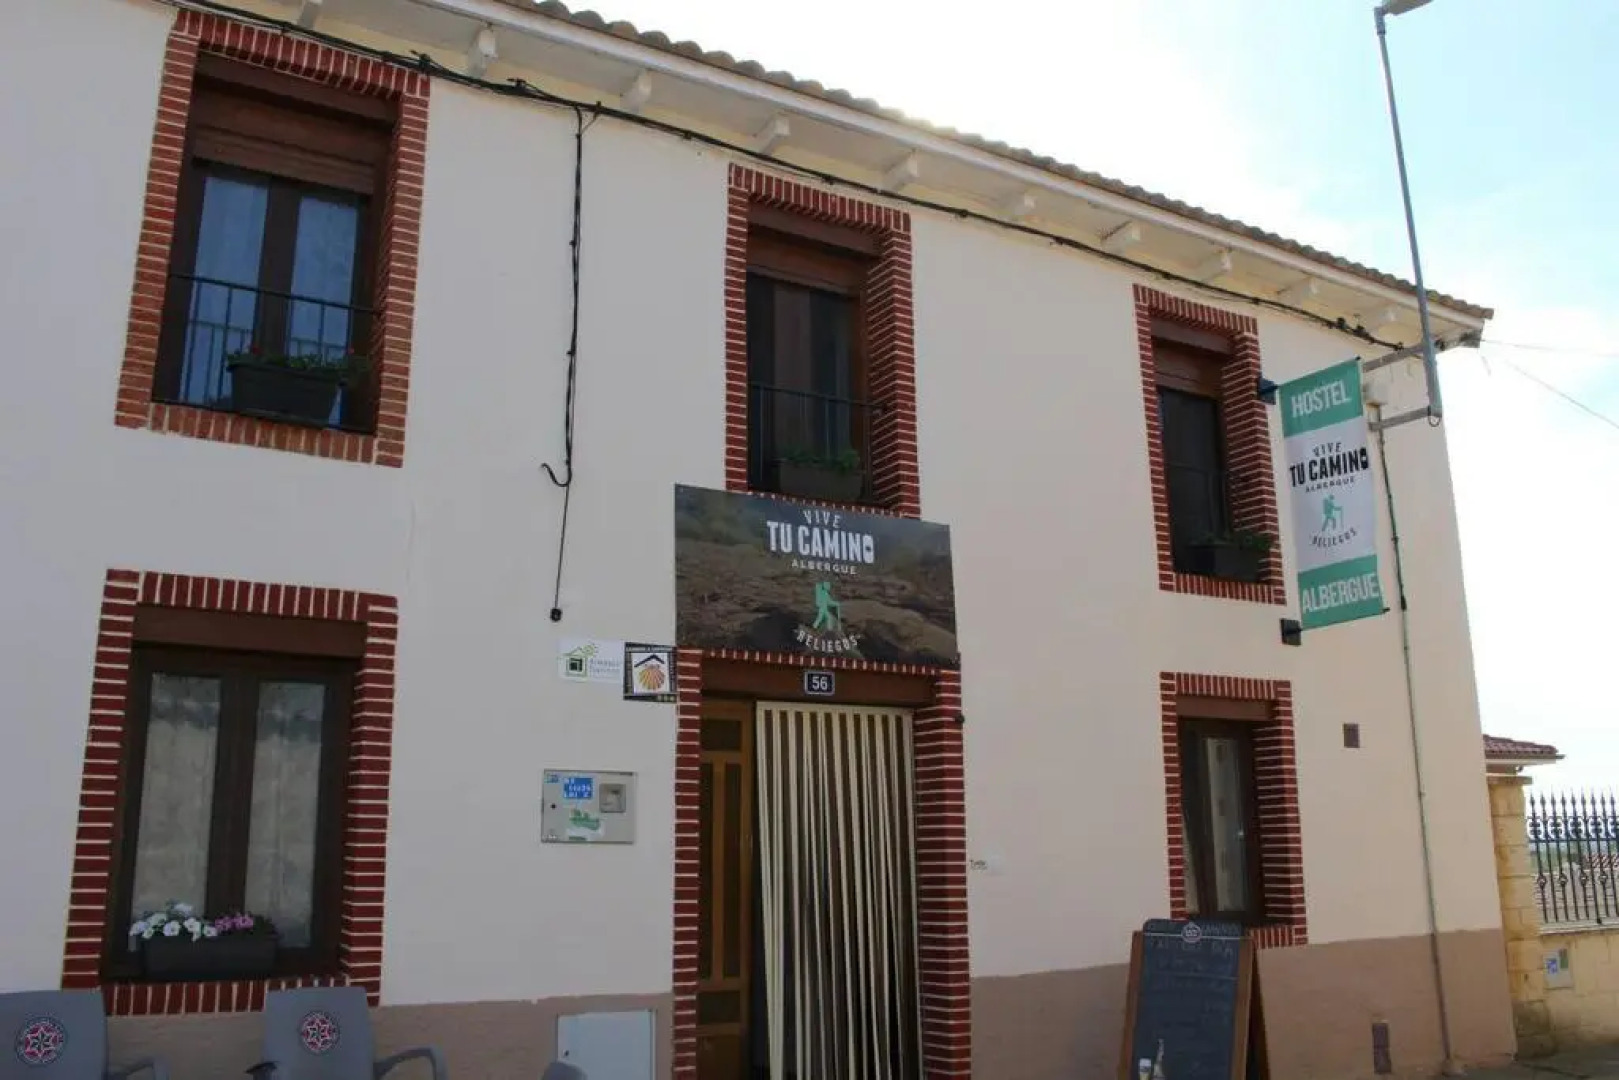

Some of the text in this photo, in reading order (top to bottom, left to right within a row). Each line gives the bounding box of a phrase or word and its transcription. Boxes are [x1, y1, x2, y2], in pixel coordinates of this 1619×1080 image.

[1291, 380, 1352, 418] HOSTEL
[1313, 442, 1342, 457] VIVE
[1290, 447, 1369, 487] TU CAMINO
[803, 510, 841, 528] VIVE
[767, 520, 874, 563] TU CAMINO
[792, 559, 857, 575] ALBERGUE
[1302, 573, 1379, 614] ALBERGUE
[812, 676, 828, 690] 56
